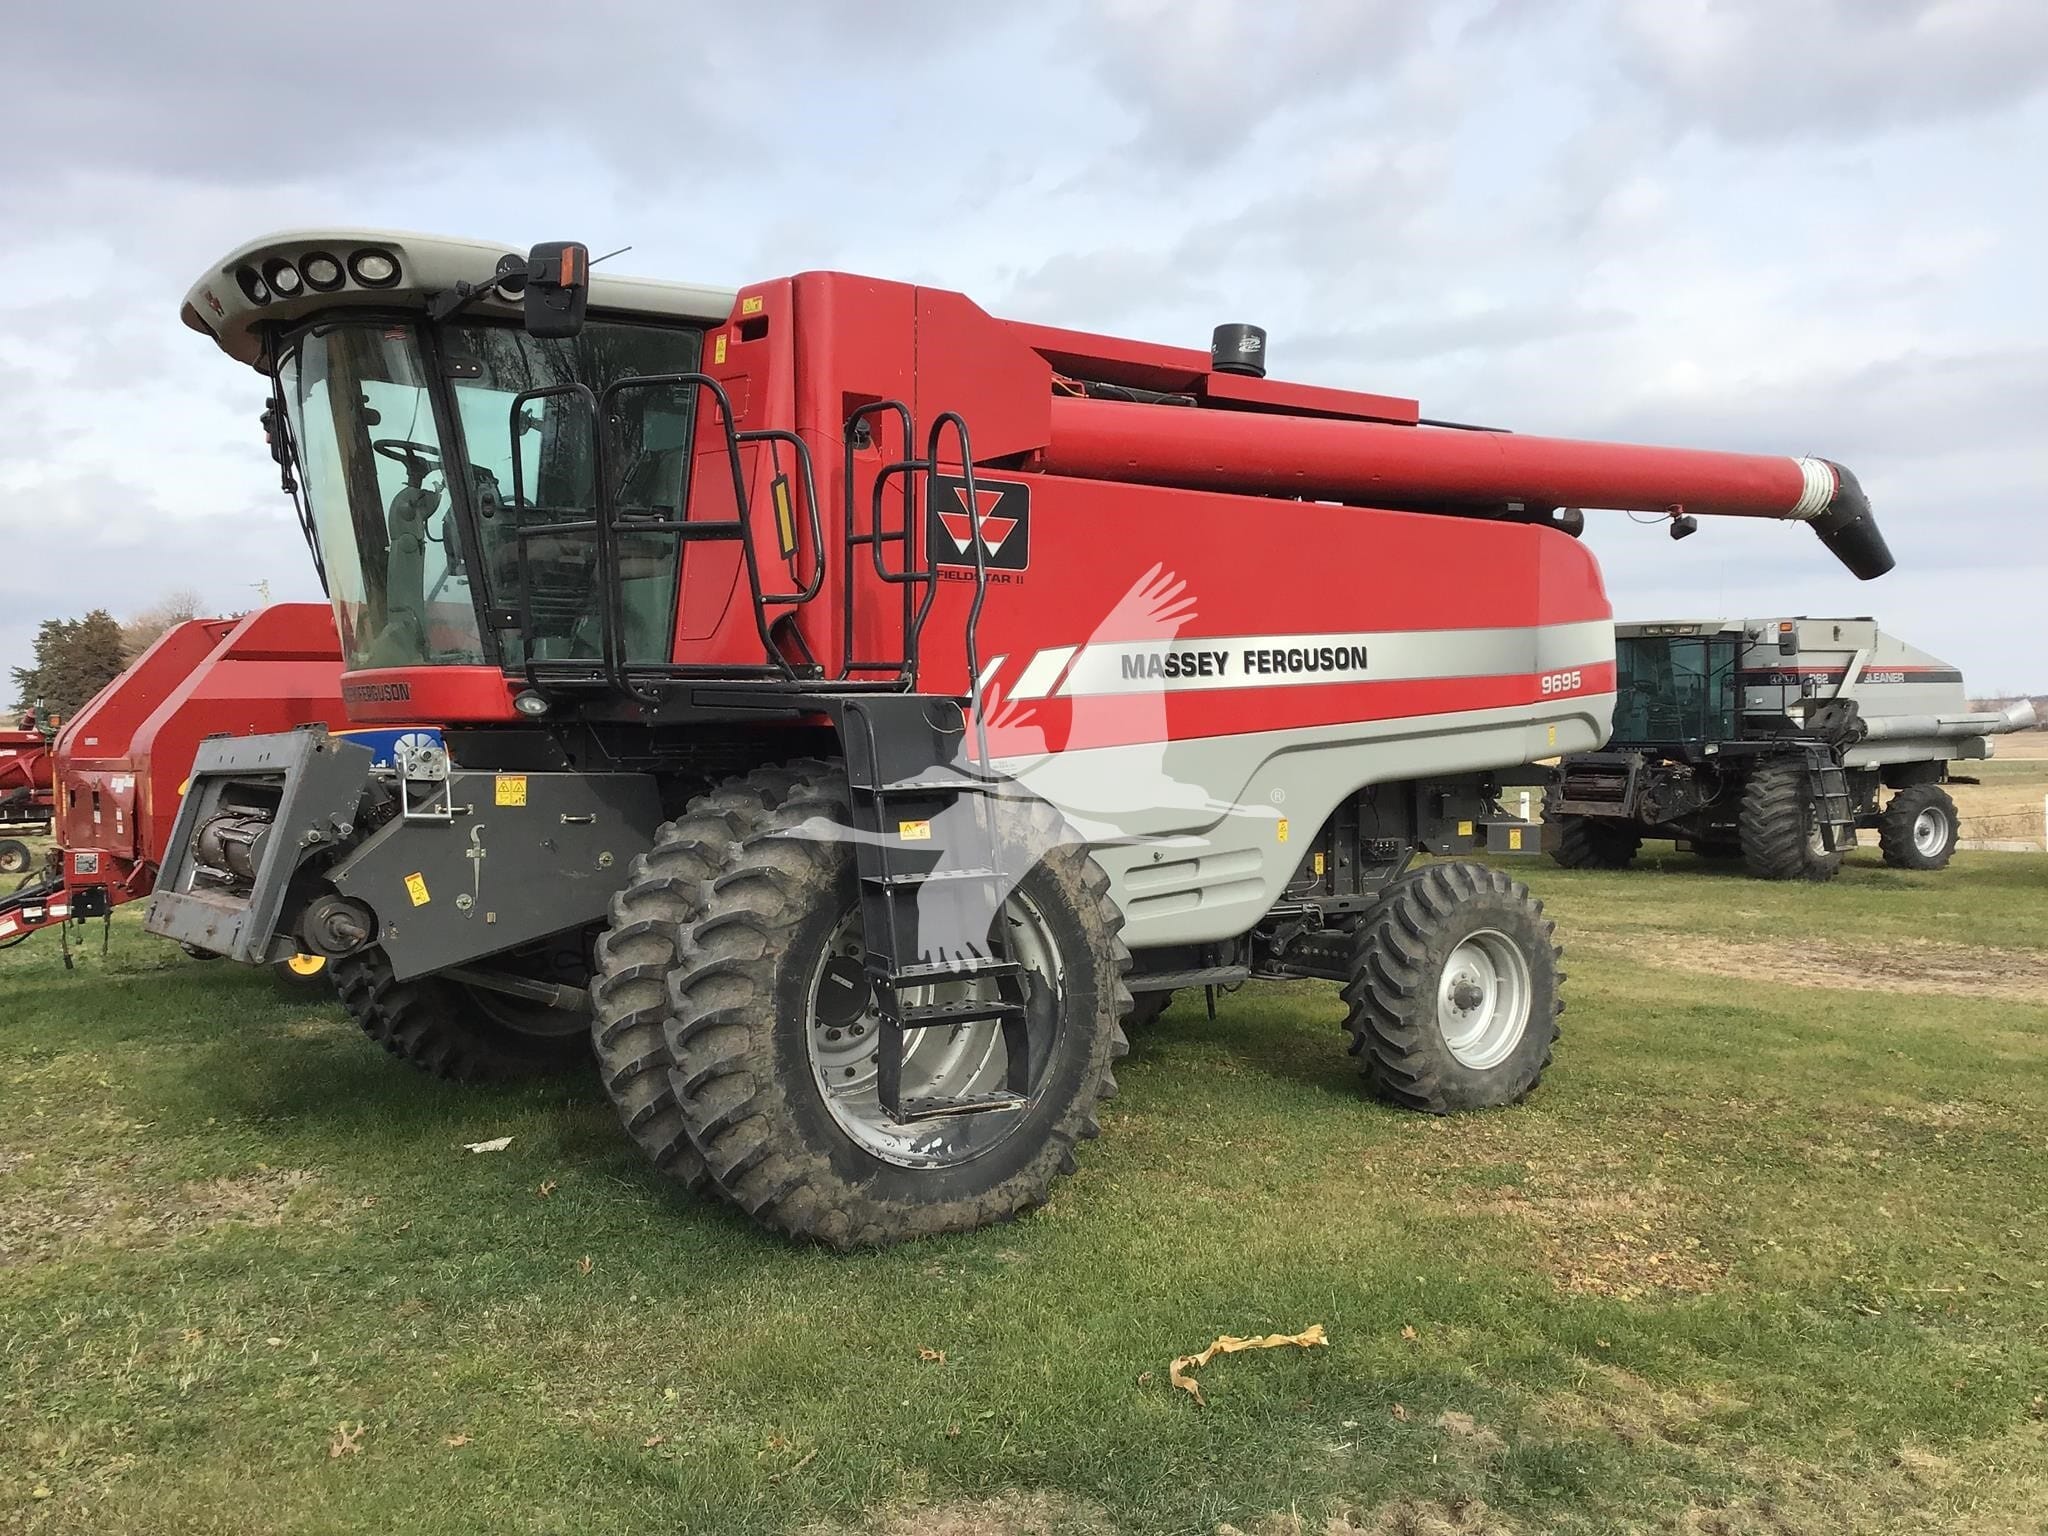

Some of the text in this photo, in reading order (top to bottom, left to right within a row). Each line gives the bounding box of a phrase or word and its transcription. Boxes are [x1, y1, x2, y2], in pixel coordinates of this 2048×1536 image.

[936, 570, 1011, 584] FIELDTAR
[1121, 646, 1368, 679] MASSEY FERGUSON
[1541, 671, 1581, 695] 9695
